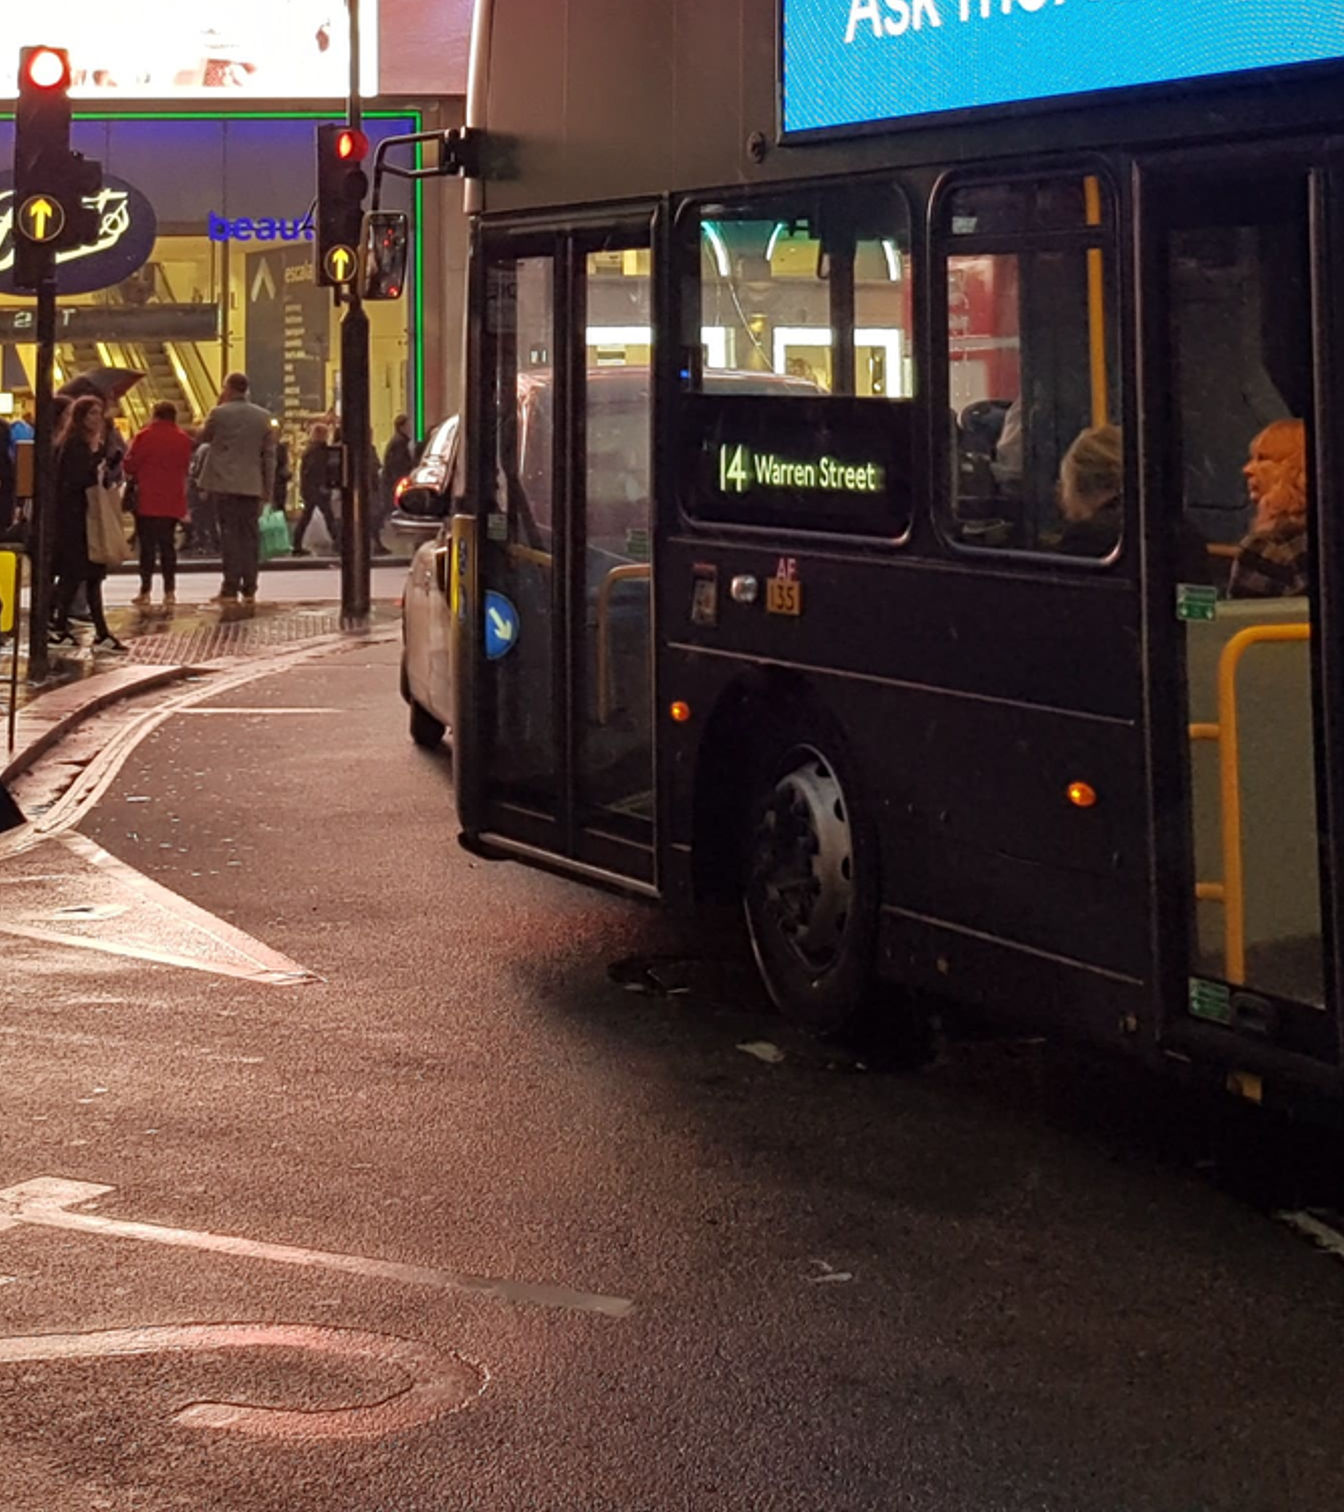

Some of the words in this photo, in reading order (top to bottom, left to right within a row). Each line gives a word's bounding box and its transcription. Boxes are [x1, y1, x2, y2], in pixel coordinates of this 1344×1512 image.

[720, 444, 747, 492] 14
[755, 454, 815, 487] Warren
[819, 456, 876, 490] Street
